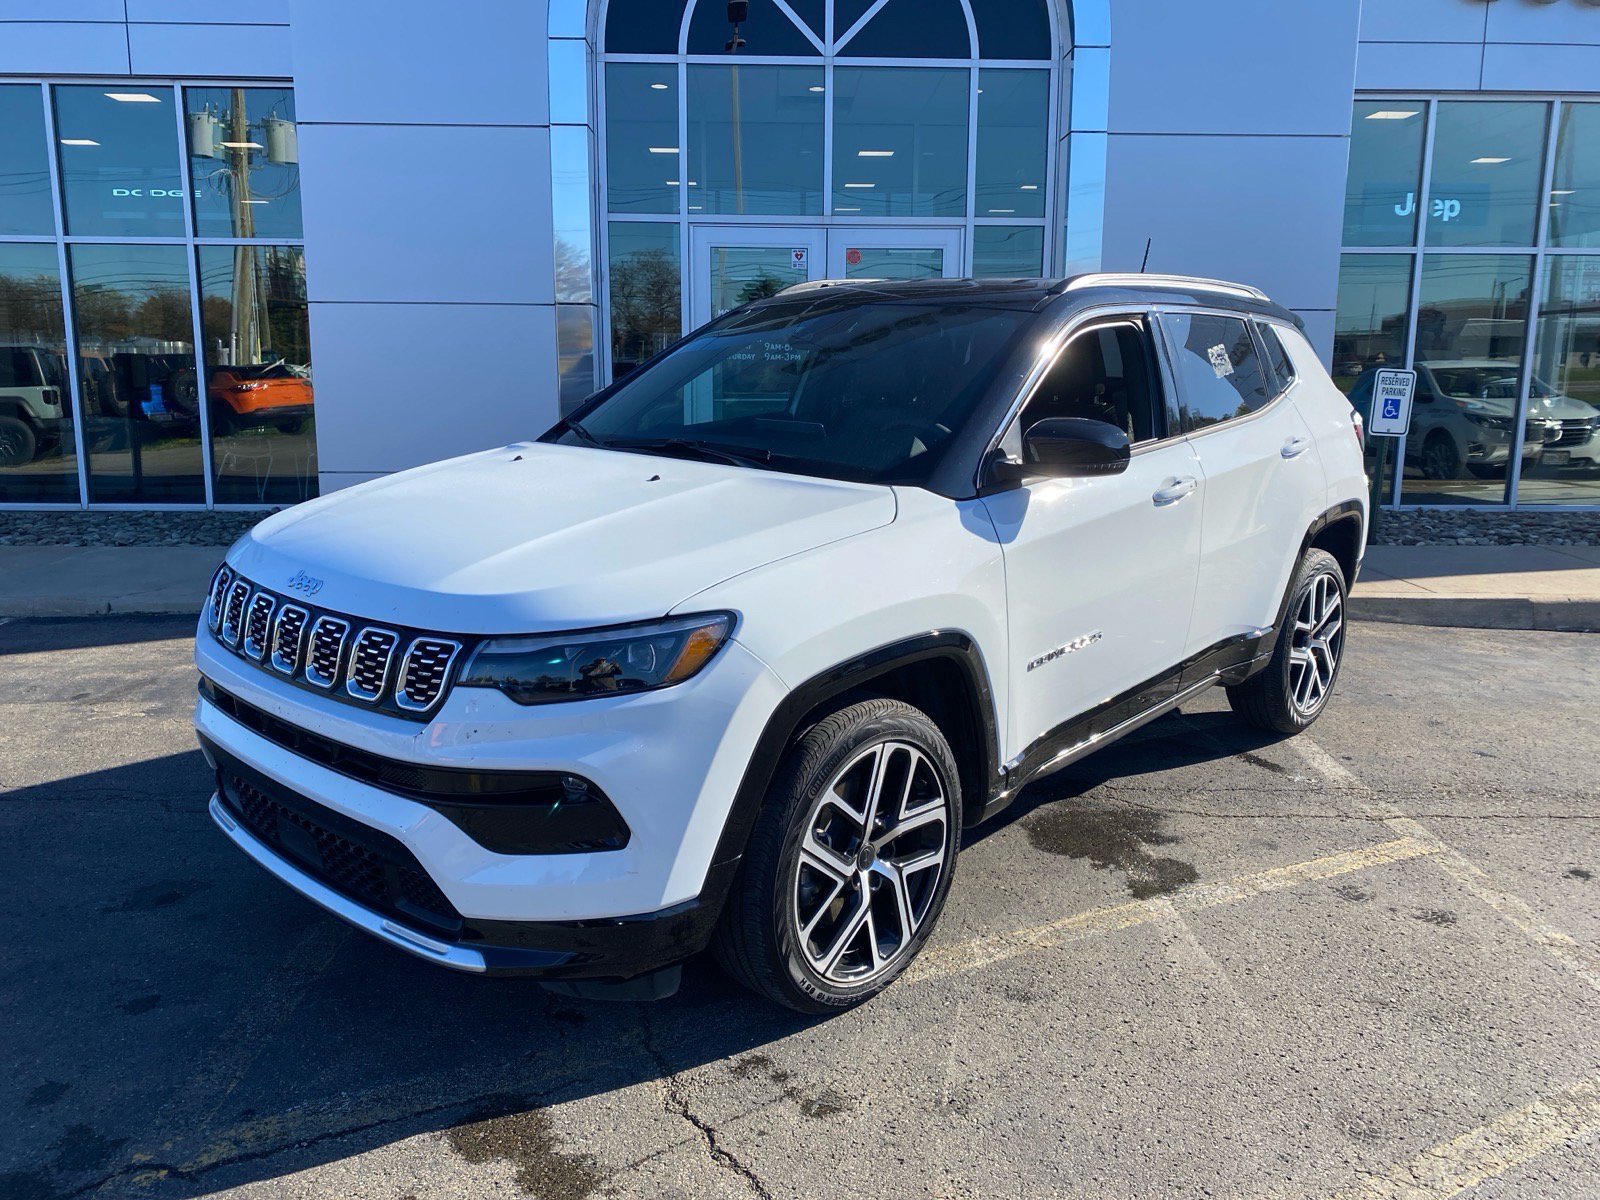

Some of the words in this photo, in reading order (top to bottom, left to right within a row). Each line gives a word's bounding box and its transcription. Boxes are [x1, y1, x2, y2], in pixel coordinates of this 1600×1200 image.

[1394, 192, 1461, 222] Jep
[764, 352, 801, 361] 9AM-3PM
[1381, 376, 1411, 387] RESERVED
[1381, 386, 1407, 397] PARKING
[288, 569, 324, 598] Jeep
